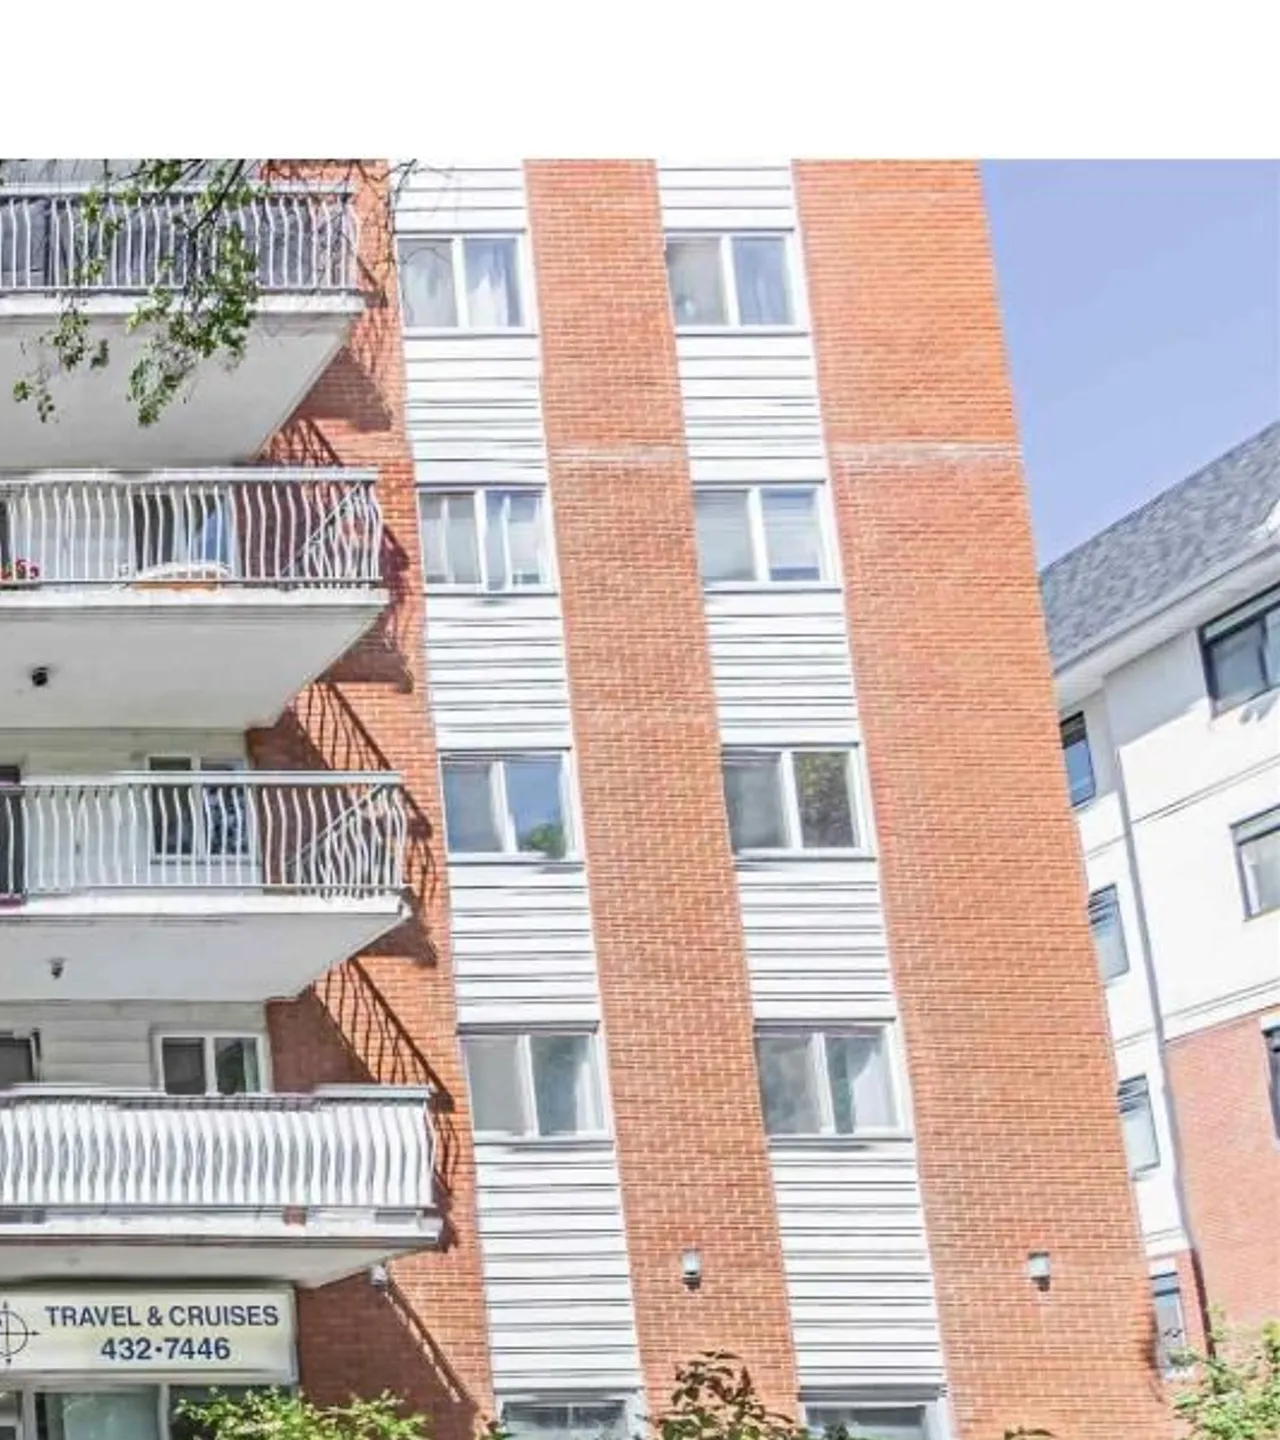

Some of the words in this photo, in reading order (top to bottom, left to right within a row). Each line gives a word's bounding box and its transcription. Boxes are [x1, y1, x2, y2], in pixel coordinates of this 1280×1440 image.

[45, 1305, 141, 1327] TRAVEL
[146, 1305, 164, 1326] &
[169, 1305, 279, 1326] CRUISES
